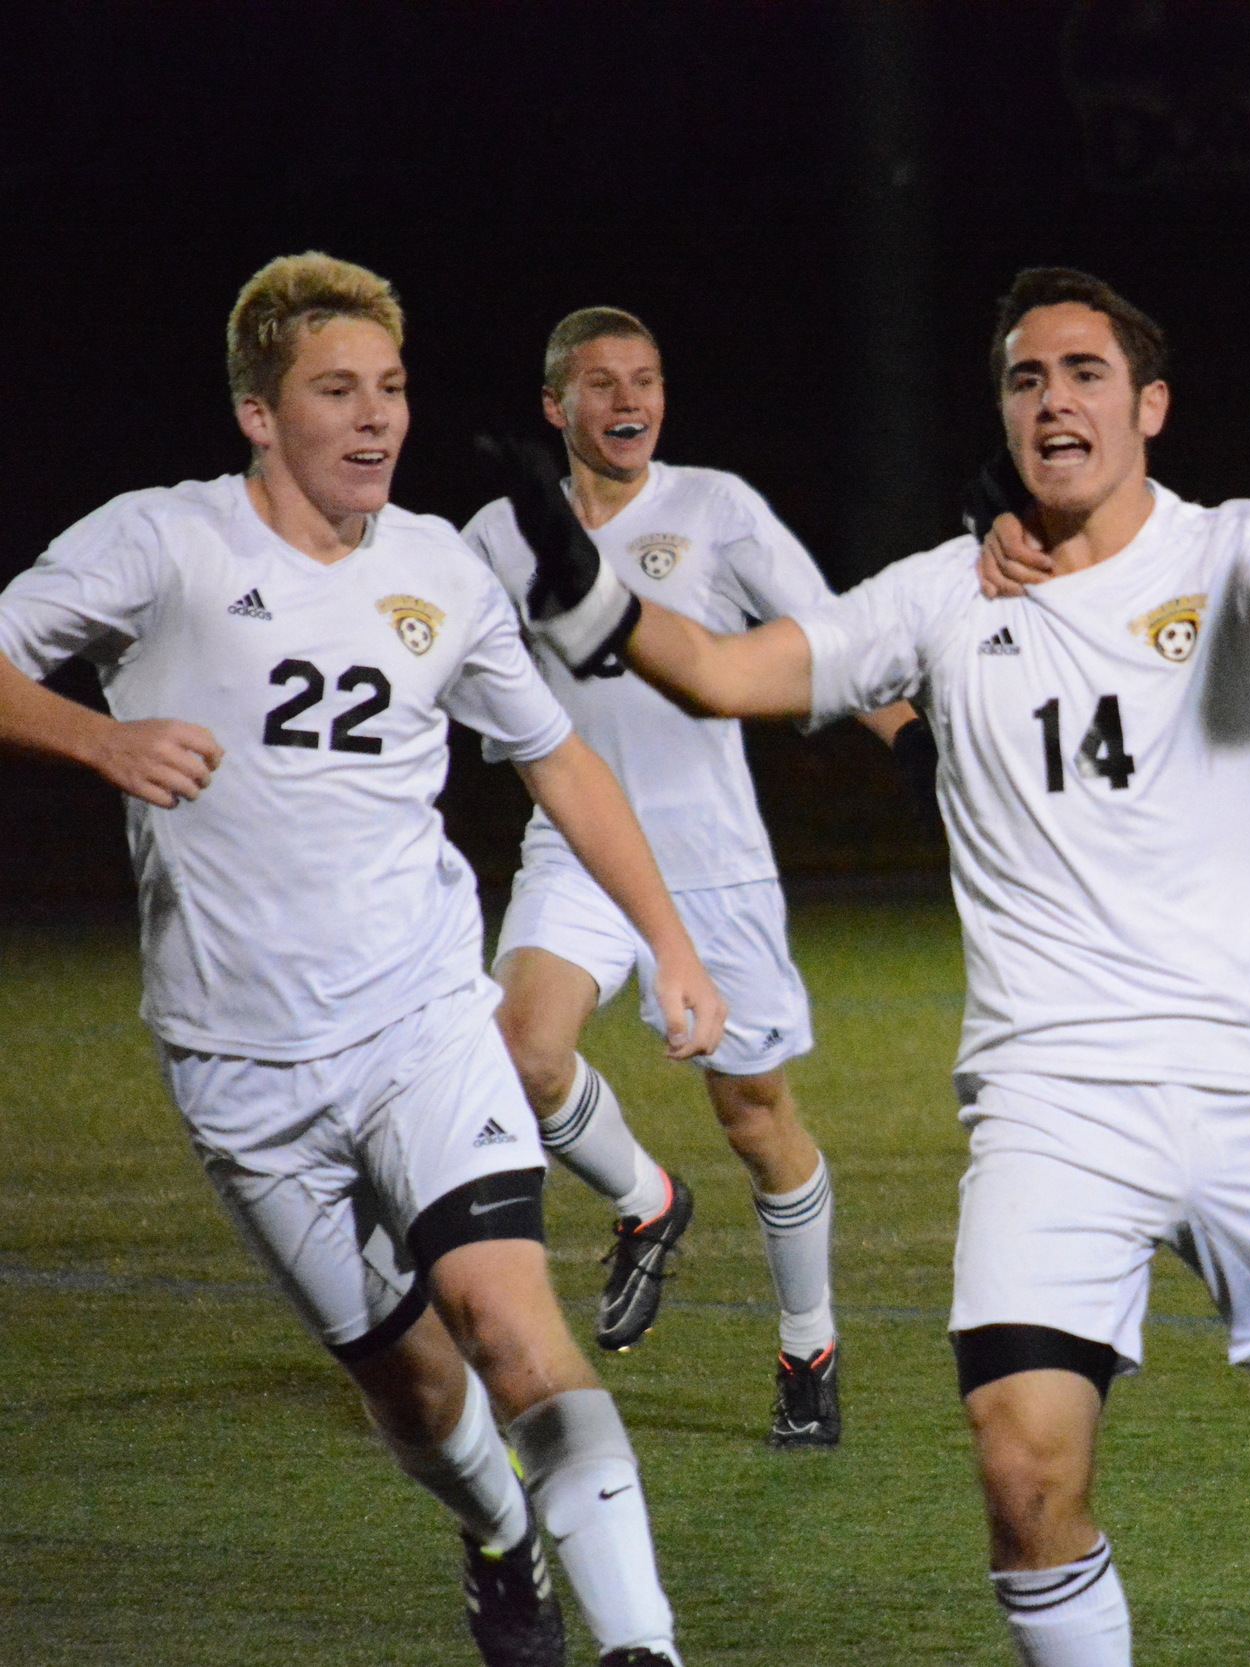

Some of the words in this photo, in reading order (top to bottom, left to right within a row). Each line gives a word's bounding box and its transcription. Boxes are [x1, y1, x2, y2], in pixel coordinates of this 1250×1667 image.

[227, 605, 273, 621] adidas
[263, 658, 392, 756] 22
[1033, 694, 1136, 793] 14
[474, 1135, 517, 1148] adidas
